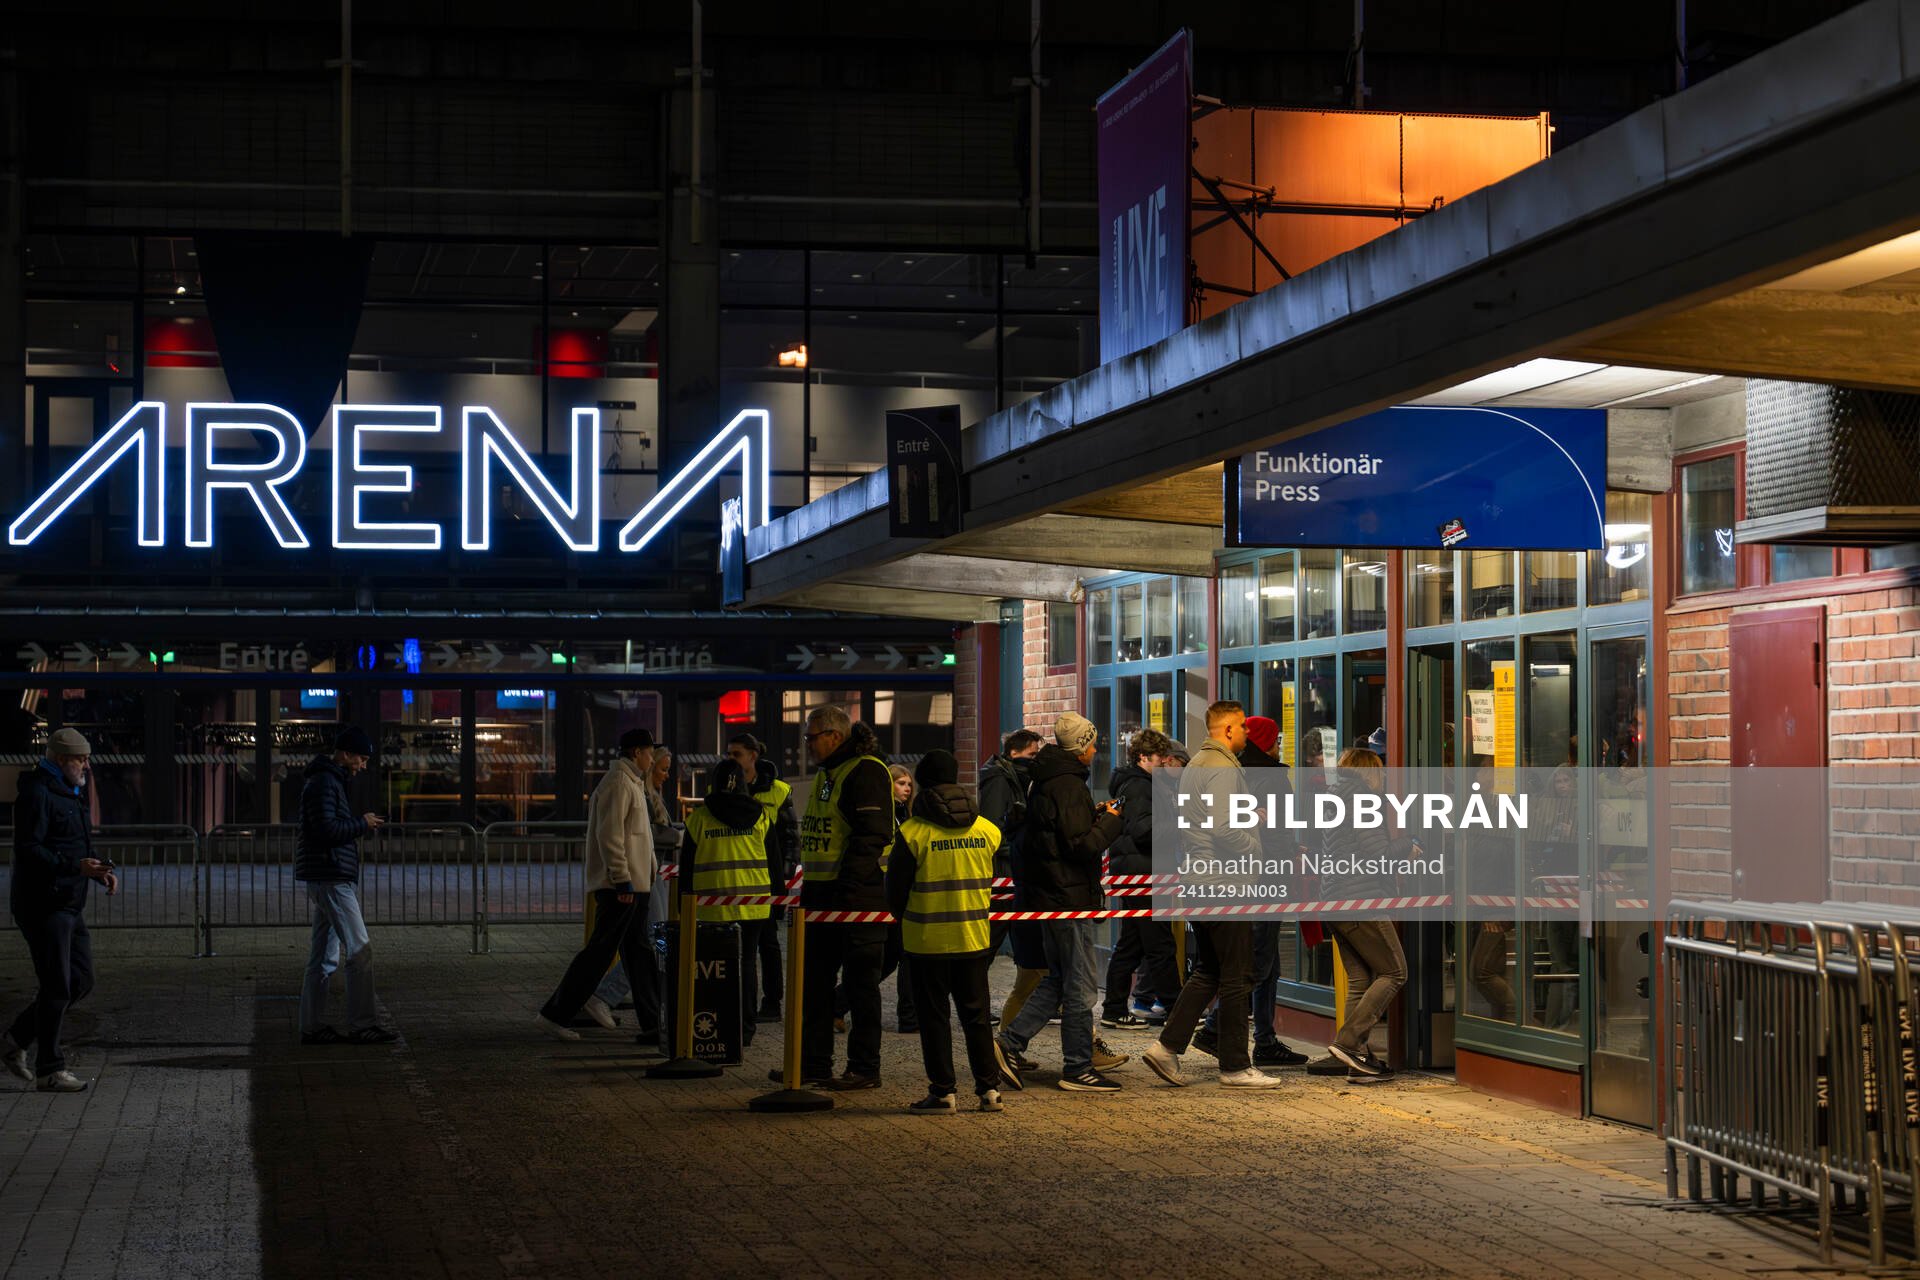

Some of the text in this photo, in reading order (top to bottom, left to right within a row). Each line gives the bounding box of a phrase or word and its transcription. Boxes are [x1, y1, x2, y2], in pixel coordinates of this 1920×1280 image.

[1118, 184, 1166, 333] LIVE
[896, 438, 930, 453] Entré
[8, 400, 770, 552] ARENA
[1255, 451, 1383, 475] Funktionär
[1255, 480, 1320, 502] Press
[219, 641, 309, 671] Entré
[931, 836, 986, 851] PUBLIKVÅRD
[695, 960, 726, 980] IVE
[695, 1043, 726, 1053] OOR
[1902, 1048, 1917, 1082] LIVE
[1817, 1077, 1828, 1108] LIVE
[1905, 1090, 1919, 1123] LIVE
